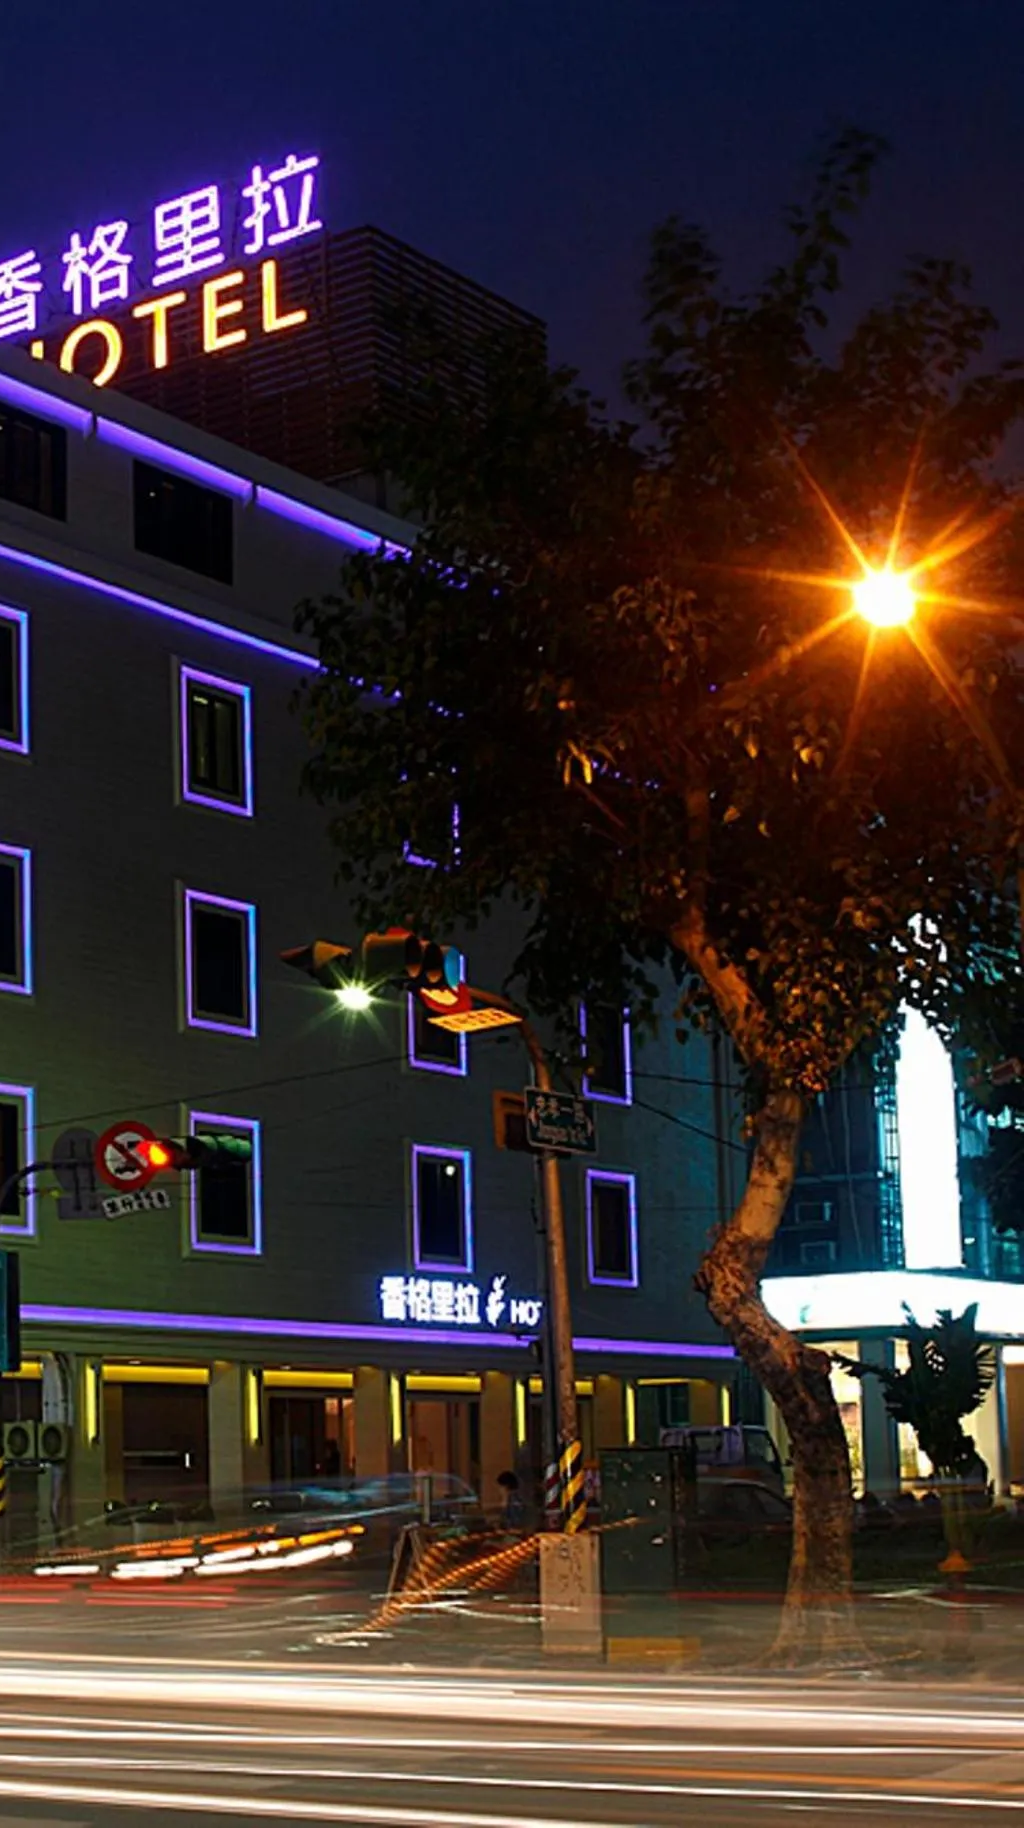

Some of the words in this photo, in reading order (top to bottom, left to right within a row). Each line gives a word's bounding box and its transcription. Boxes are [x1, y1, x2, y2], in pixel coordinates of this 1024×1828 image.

[31, 258, 309, 389] OTEL
[380, 1275, 481, 1325] 香格里拉
[511, 1299, 543, 1326] HO
